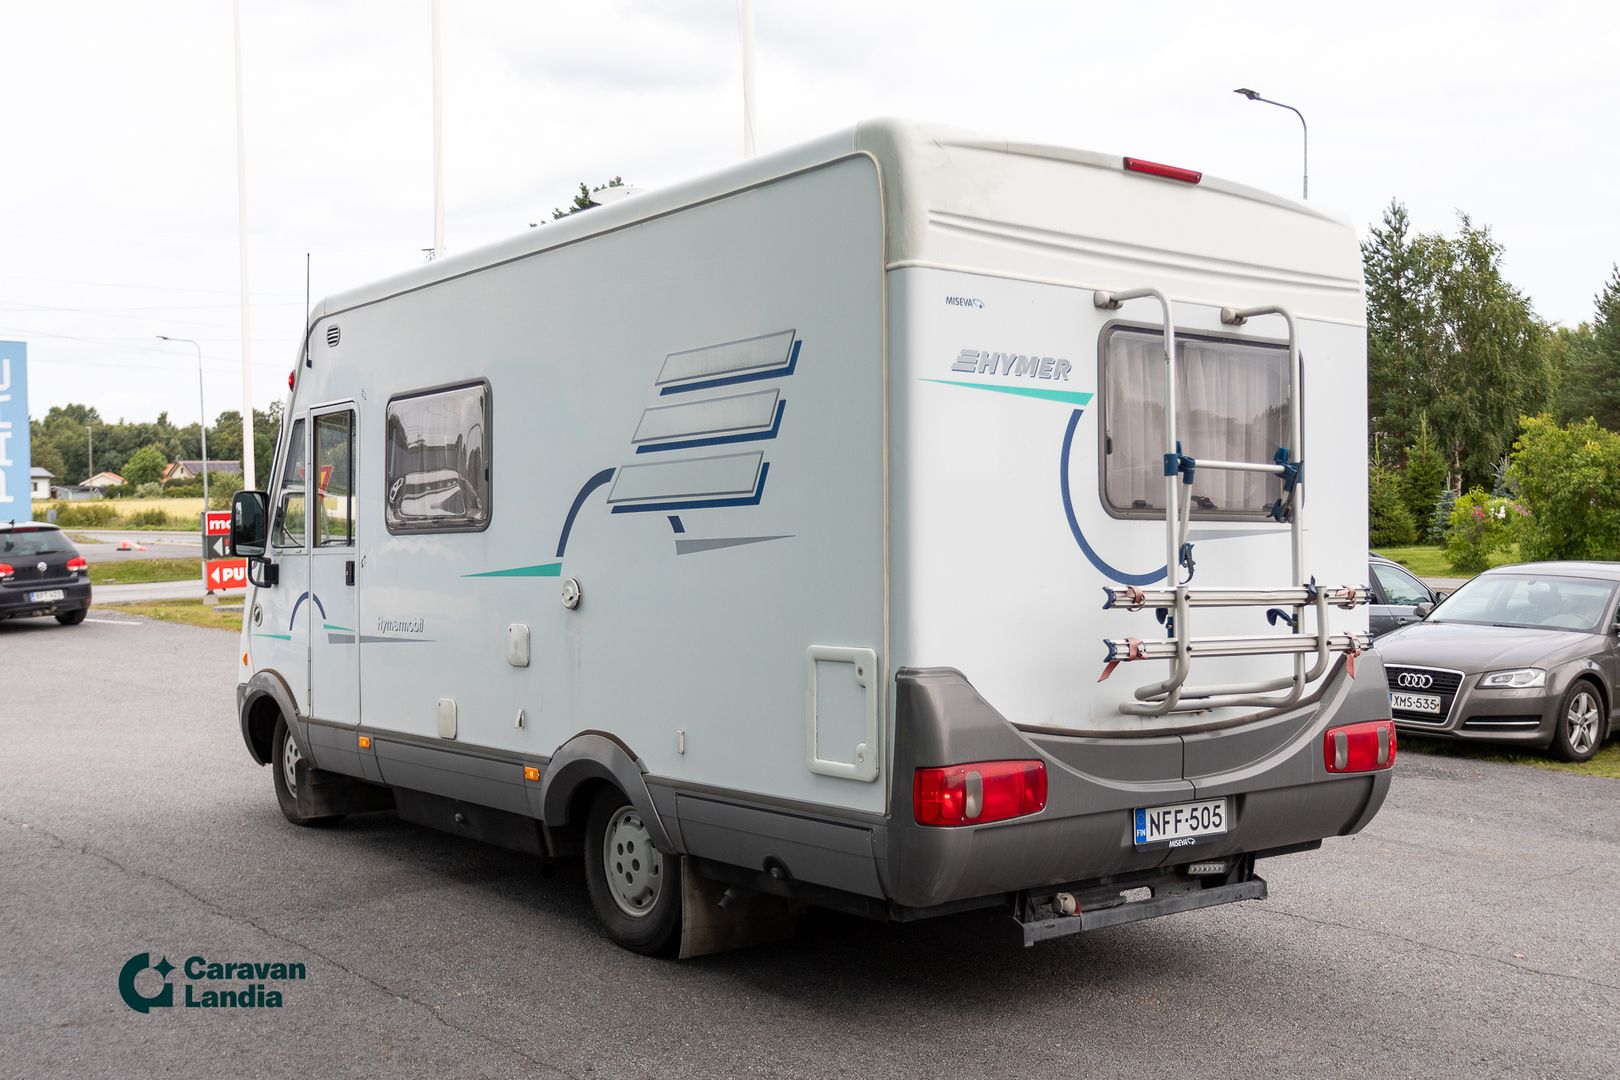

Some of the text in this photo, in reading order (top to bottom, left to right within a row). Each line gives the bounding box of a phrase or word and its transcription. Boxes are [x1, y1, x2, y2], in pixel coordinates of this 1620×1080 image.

[945, 296, 973, 308] MISEVA
[977, 350, 1072, 381] HYMER
[1393, 695, 1437, 710] XMS-535
[1149, 804, 1223, 837] NFF-505
[1168, 838, 1189, 848] MISEVA
